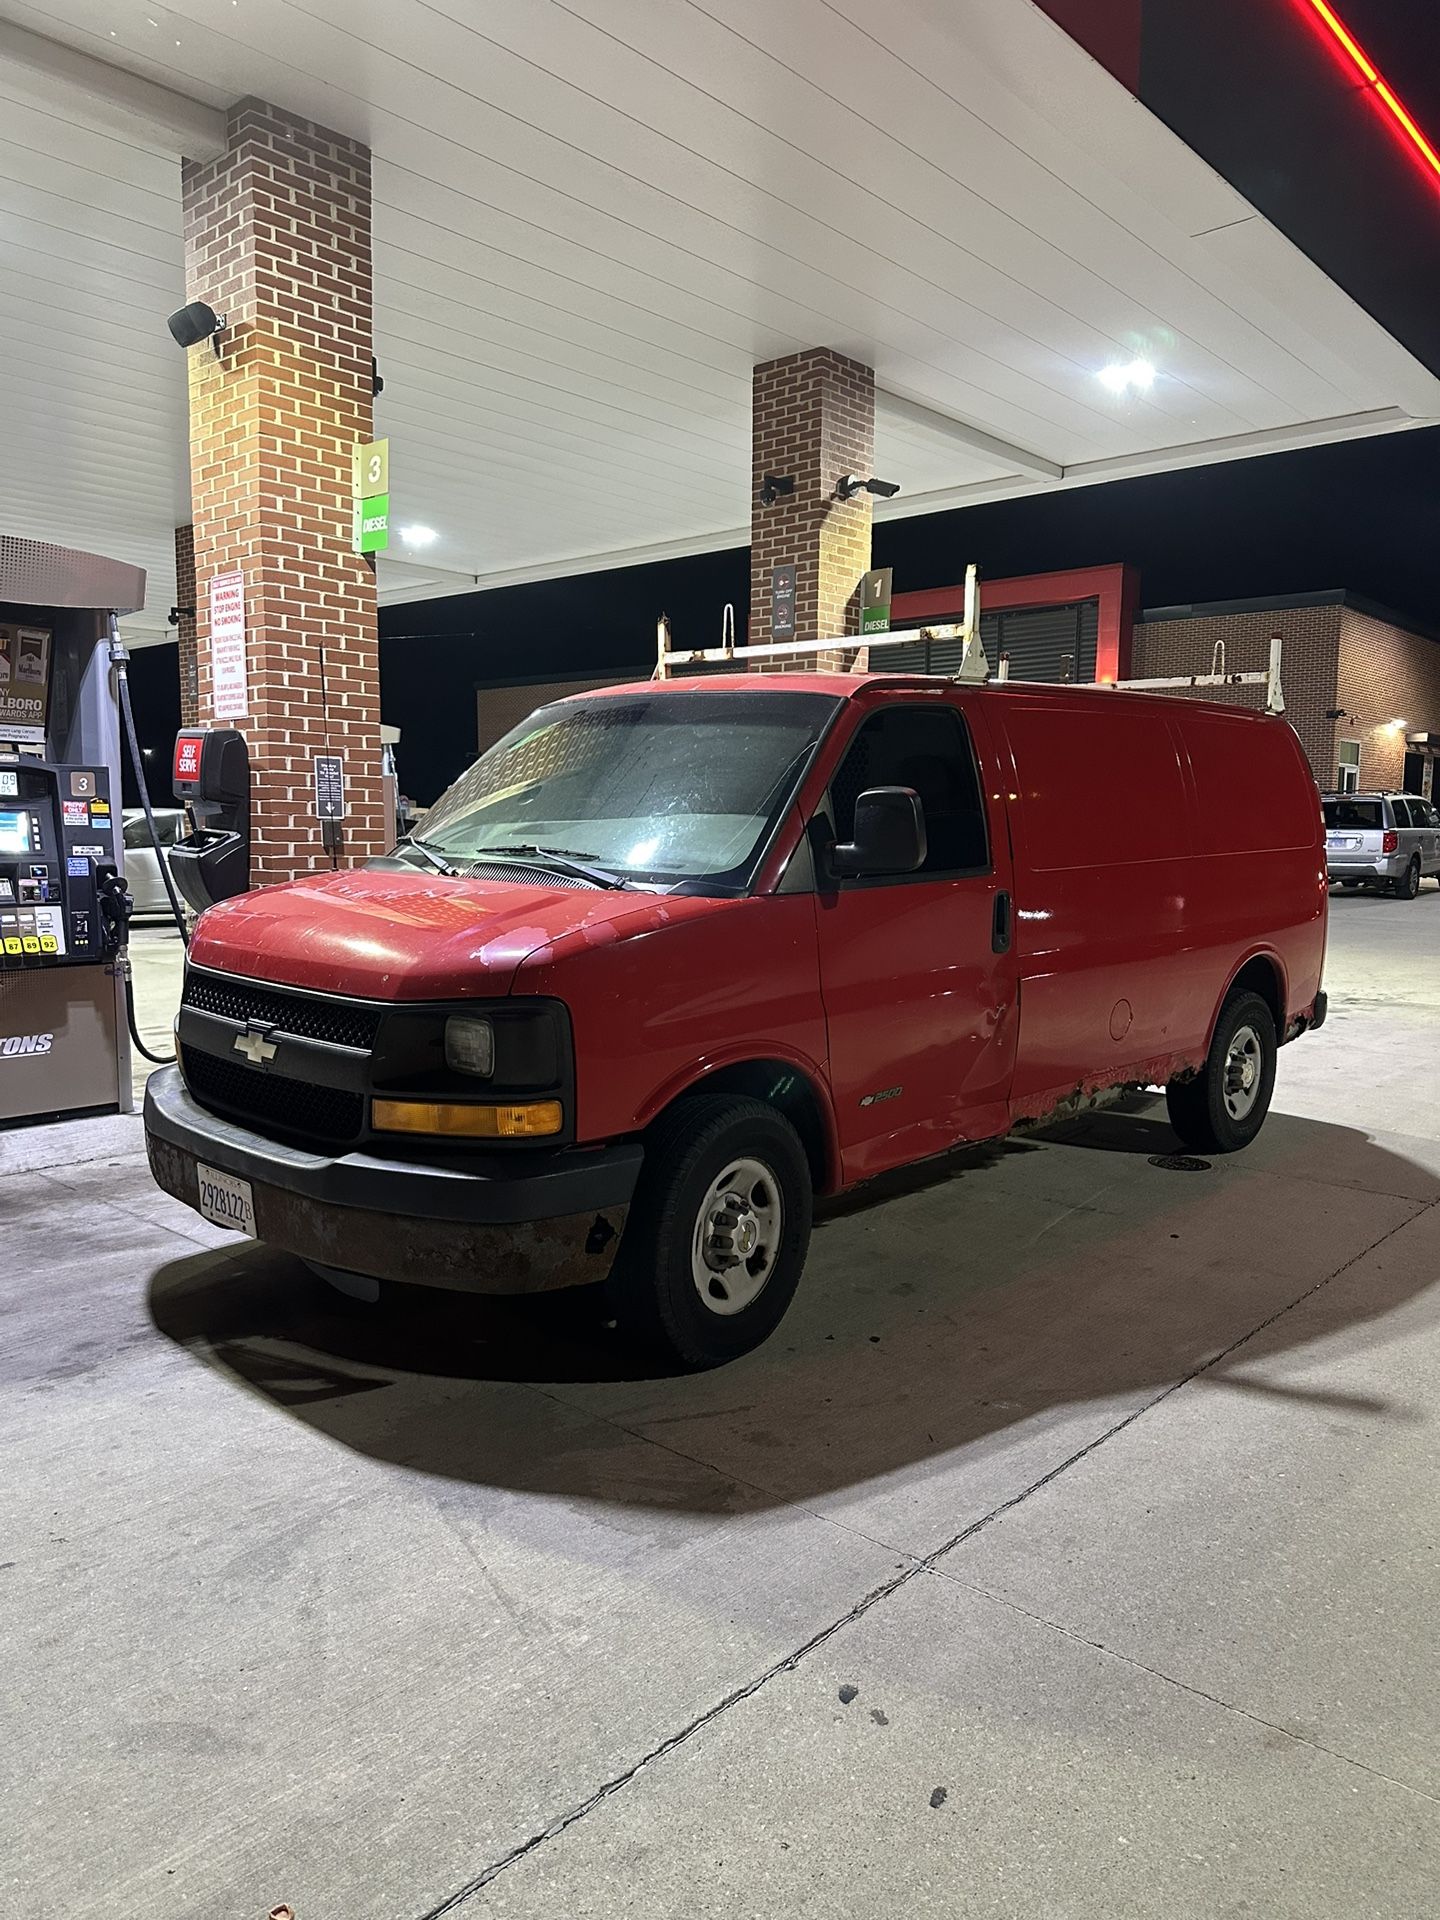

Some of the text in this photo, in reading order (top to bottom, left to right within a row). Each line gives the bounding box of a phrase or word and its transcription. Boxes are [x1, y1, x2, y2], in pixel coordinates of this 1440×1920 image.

[368, 455, 382, 483] 3
[363, 515, 388, 533] DIESEL
[215, 588, 239, 601] WARNING
[873, 578, 882, 598] 1
[214, 601, 241, 614] STOP ENGINE
[214, 613, 241, 626] NO SMOKING
[864, 619, 889, 632] DIESEL
[28, 711, 43, 720] APP
[181, 744, 197, 758] SELF
[179, 758, 197, 773] SERVE
[78, 777, 88, 791] 3
[874, 1086, 904, 1103] 2500
